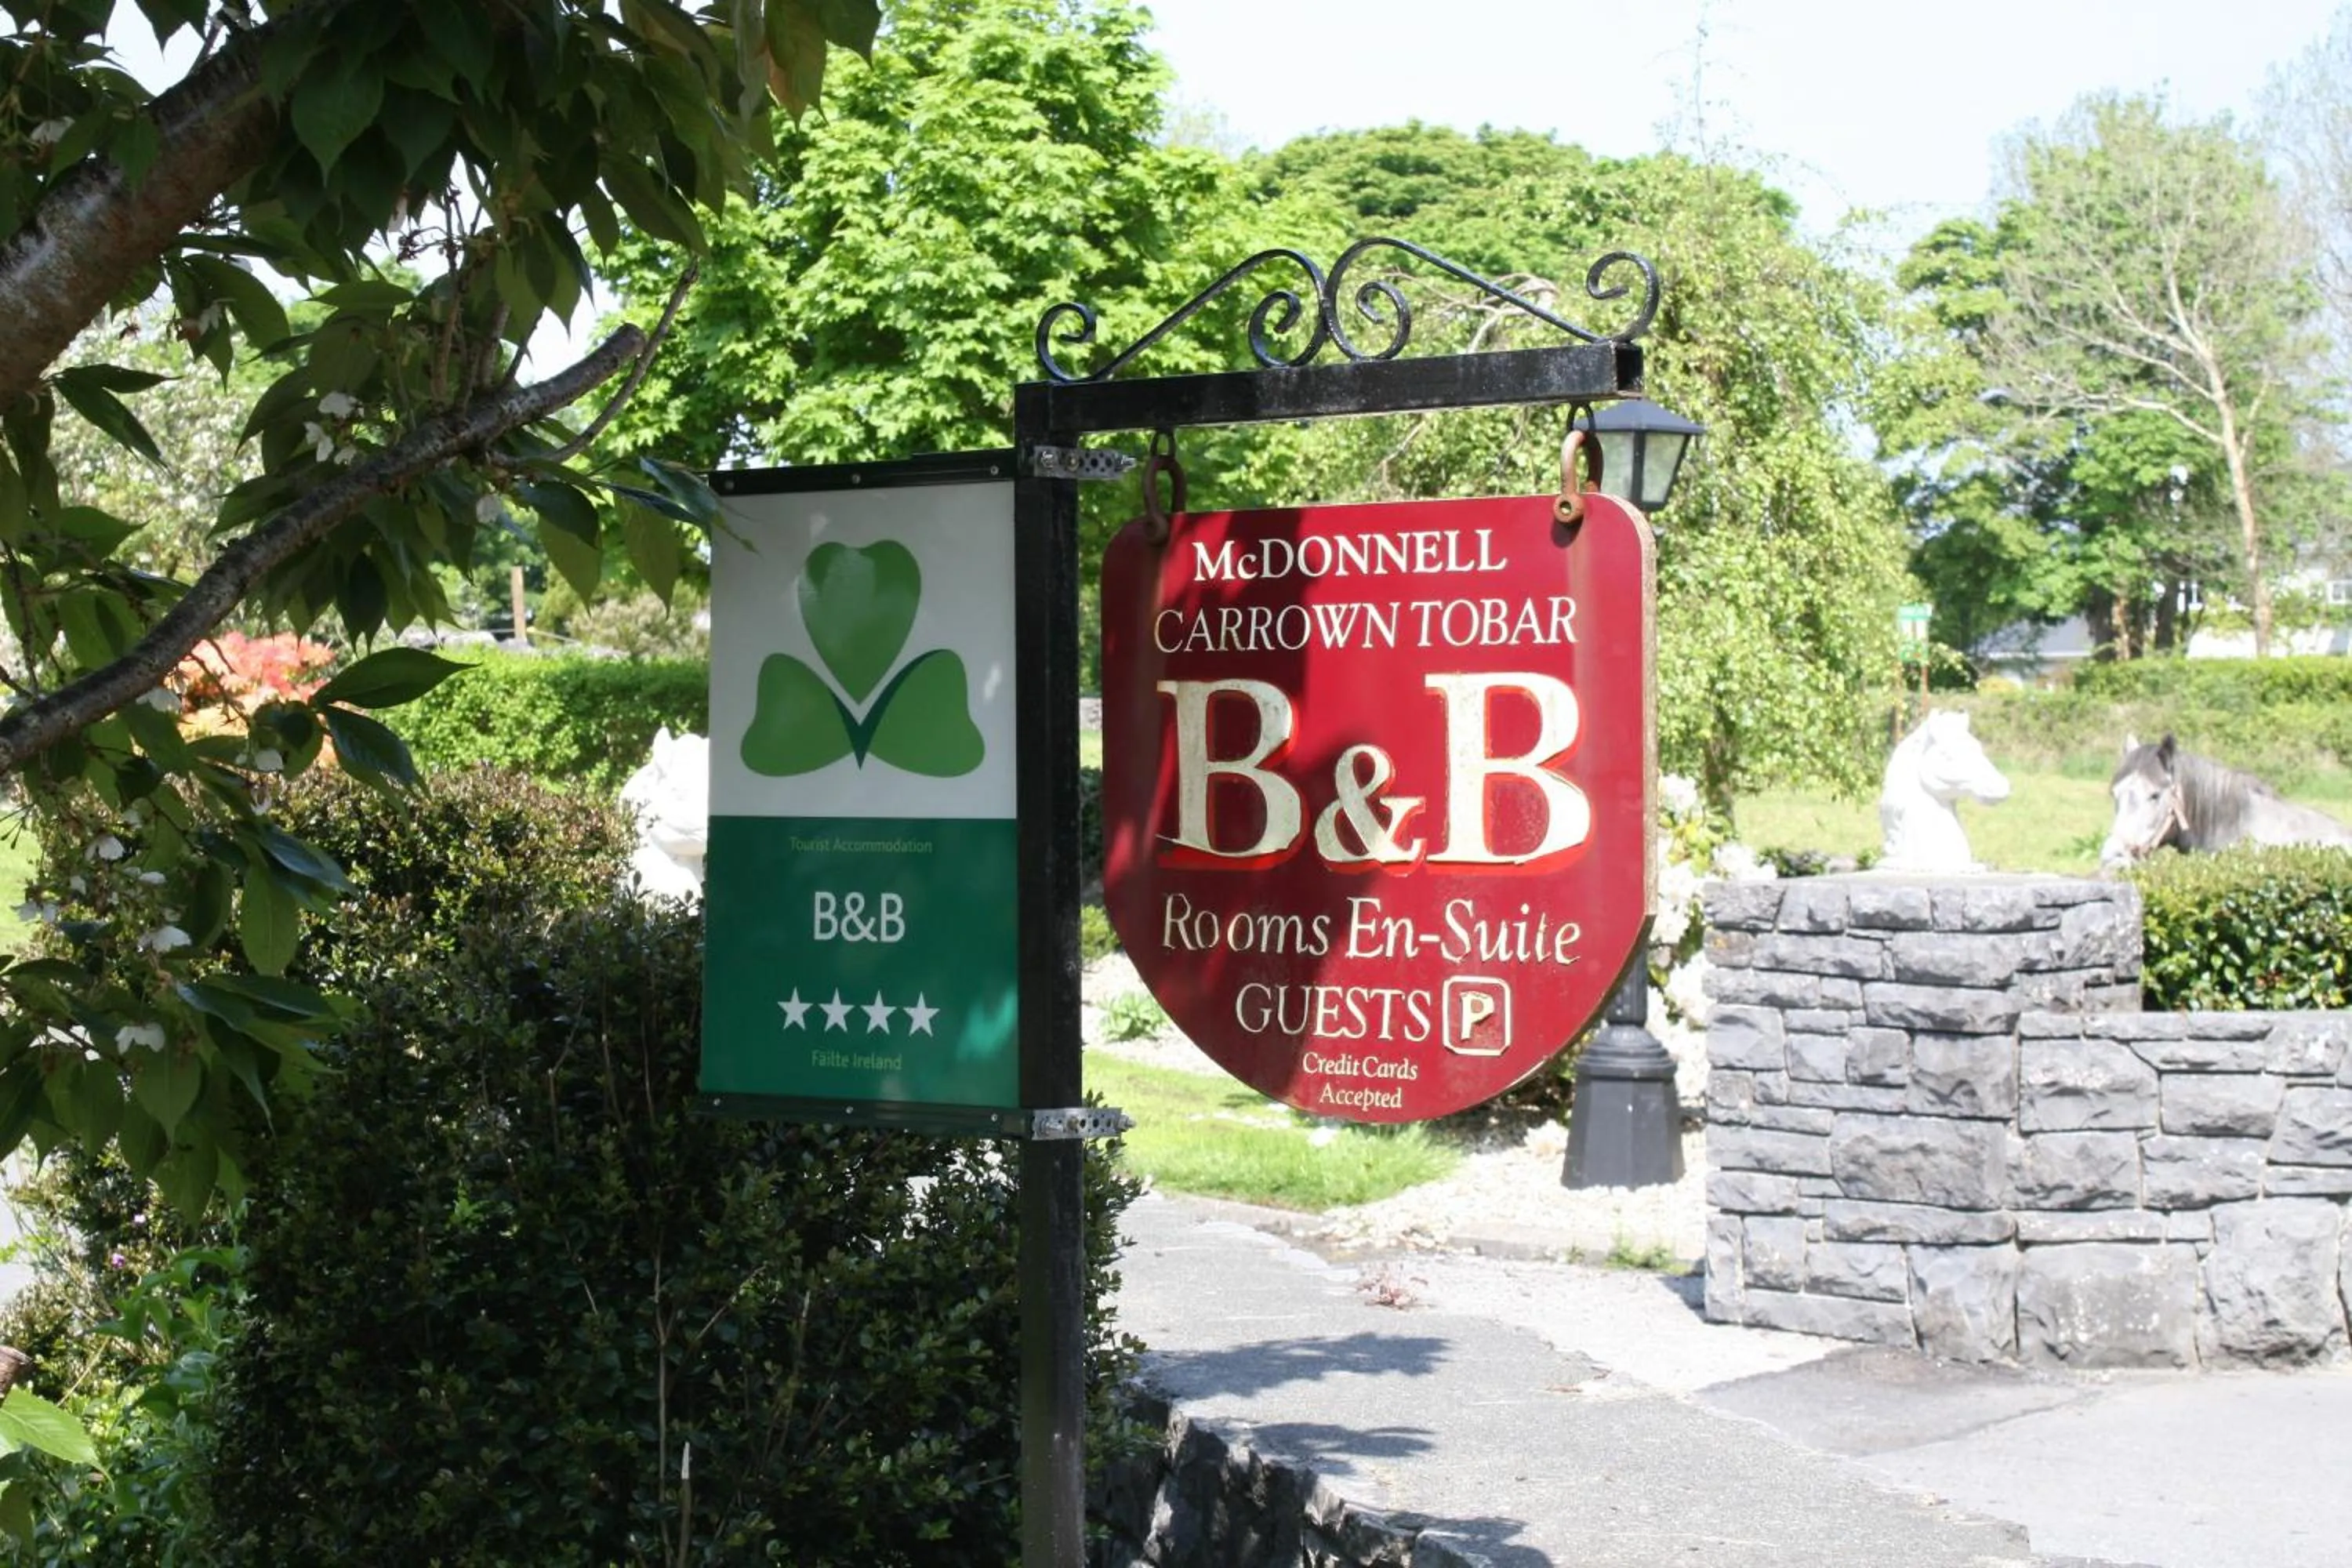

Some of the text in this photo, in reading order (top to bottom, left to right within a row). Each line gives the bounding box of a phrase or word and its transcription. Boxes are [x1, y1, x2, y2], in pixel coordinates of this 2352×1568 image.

[1192, 529, 1507, 582] McDONNELL
[1155, 596, 1580, 653] CARROWN TOBAR
[1156, 671, 1591, 866] B&B
[789, 836, 933, 855] Tourist Accommodation
[814, 891, 906, 943] B&B
[1162, 892, 1581, 965] Rooms En-Suite
[1235, 982, 1432, 1042] GUESTS
[853, 1052, 902, 1070] Ireland
[1302, 1051, 1419, 1080] Credit Cards
[1318, 1081, 1403, 1112] Accepted
